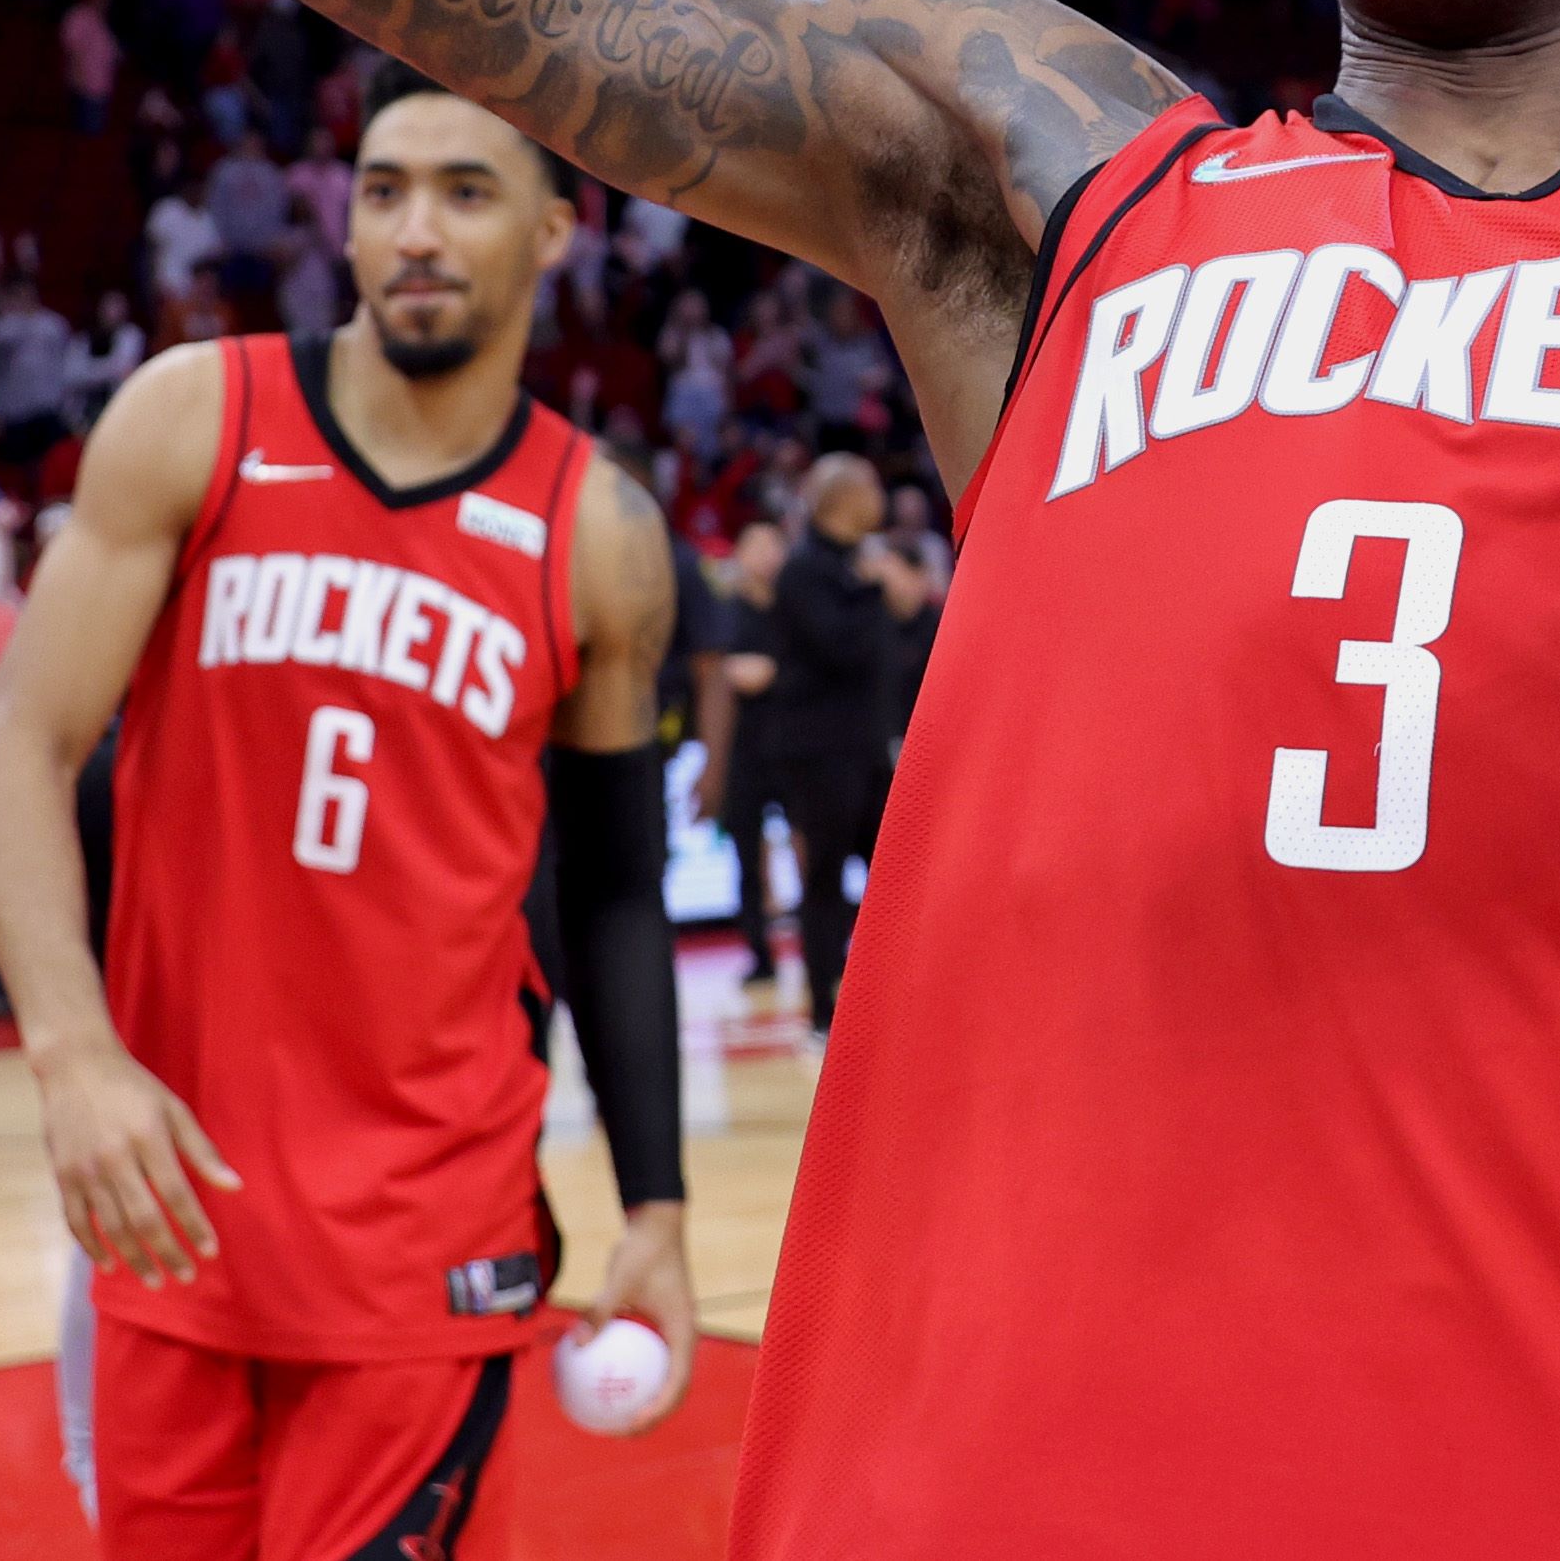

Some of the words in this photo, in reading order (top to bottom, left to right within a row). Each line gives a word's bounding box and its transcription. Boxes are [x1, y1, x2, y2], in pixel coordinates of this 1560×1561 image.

[198, 552, 526, 739] ROCKETS
[1264, 498, 1464, 872] 3
[292, 705, 376, 875] 6
